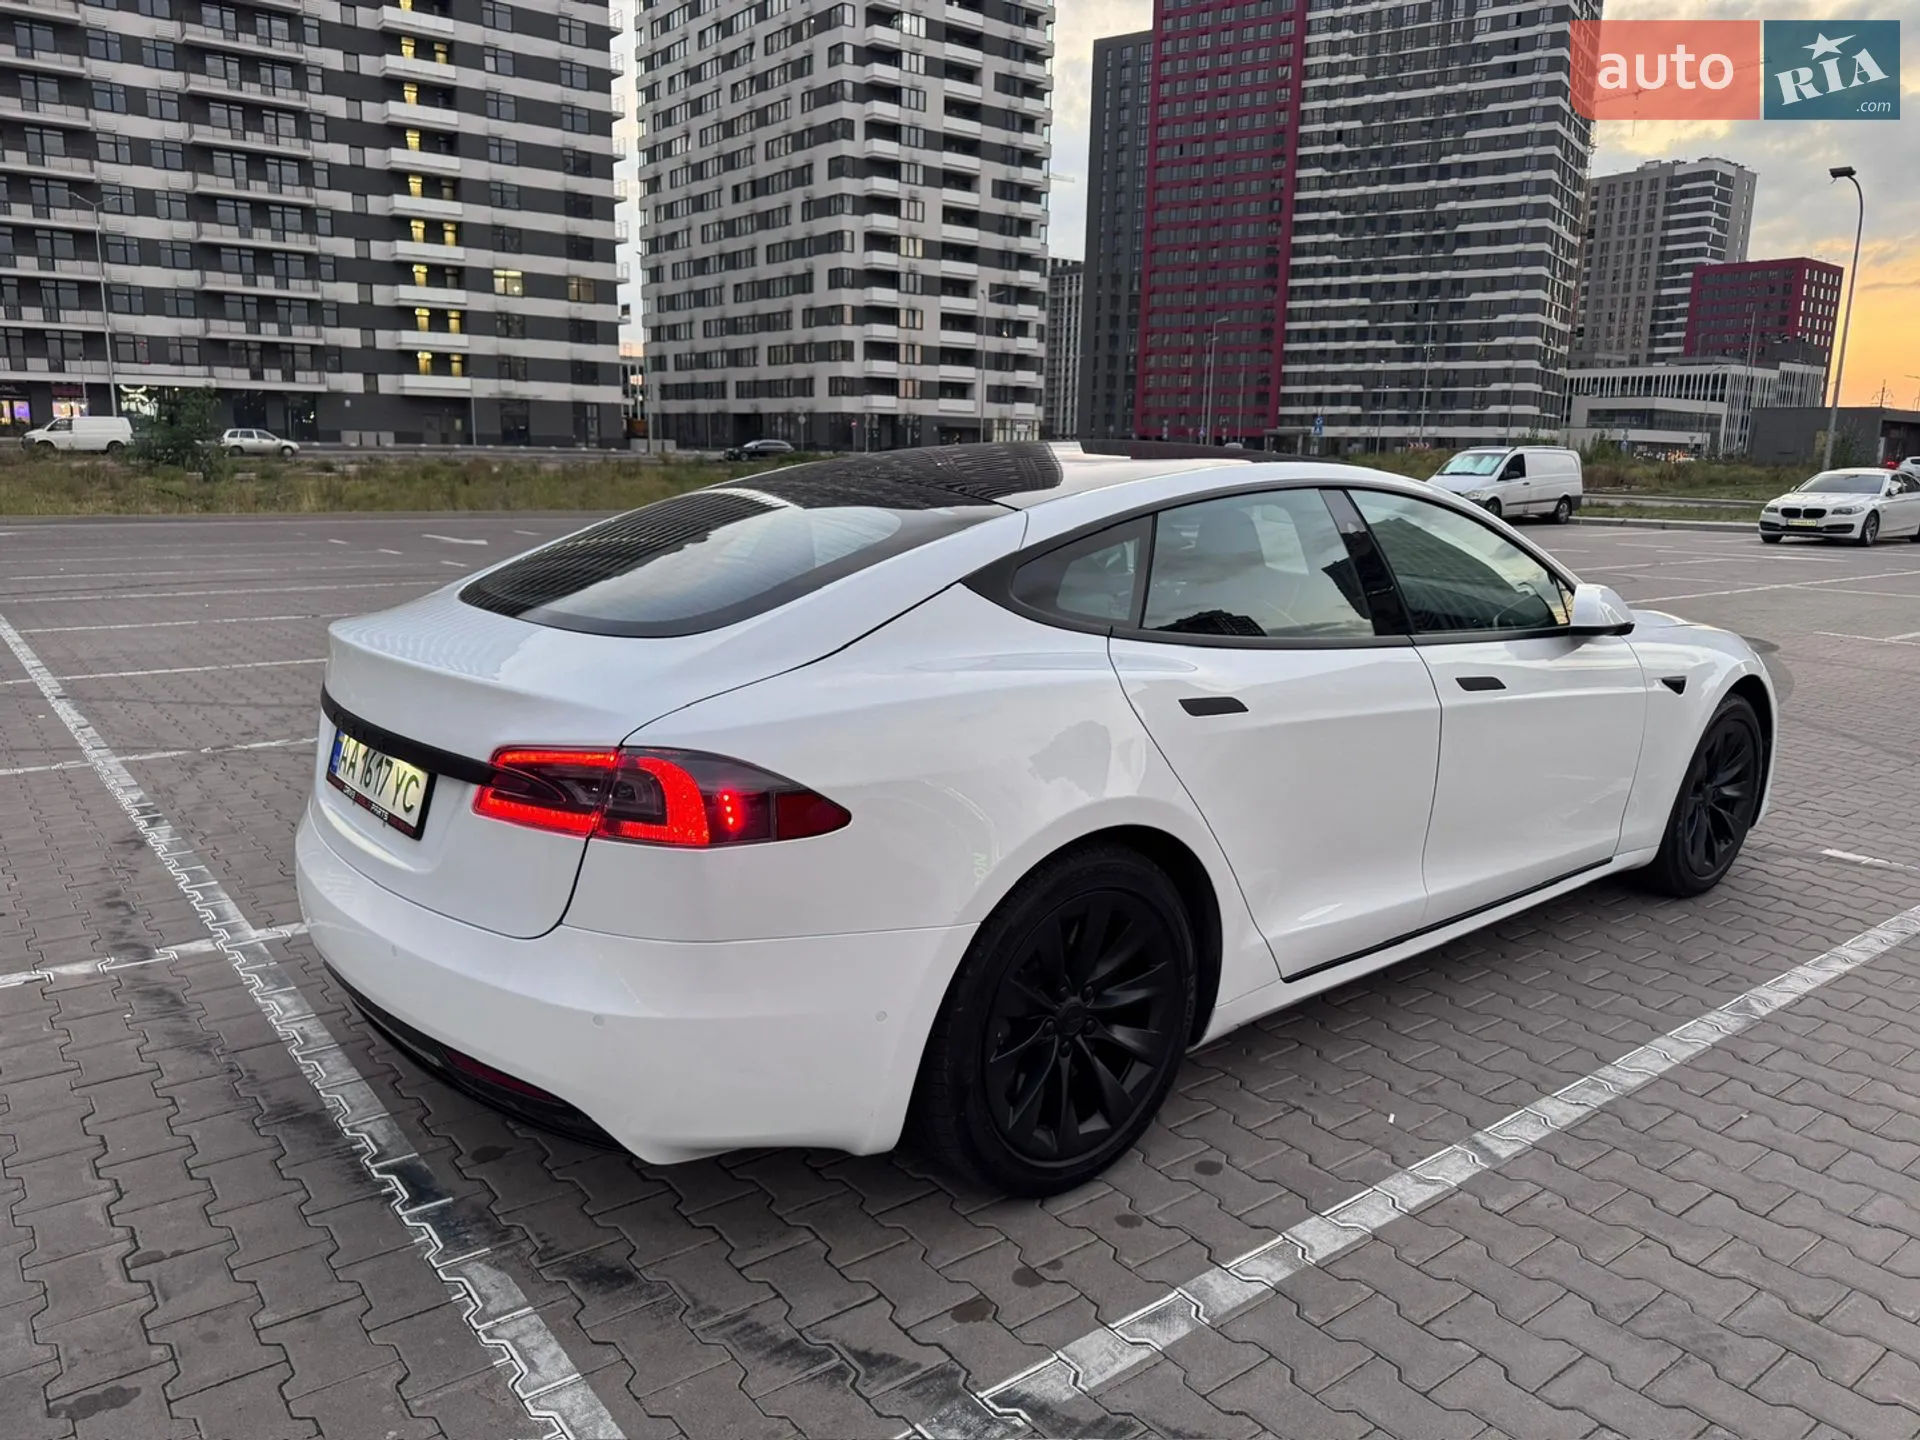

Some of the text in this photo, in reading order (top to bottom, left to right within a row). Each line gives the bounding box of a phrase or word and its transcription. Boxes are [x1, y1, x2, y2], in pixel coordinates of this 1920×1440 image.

[339, 737, 420, 814] AA 1617 YC
